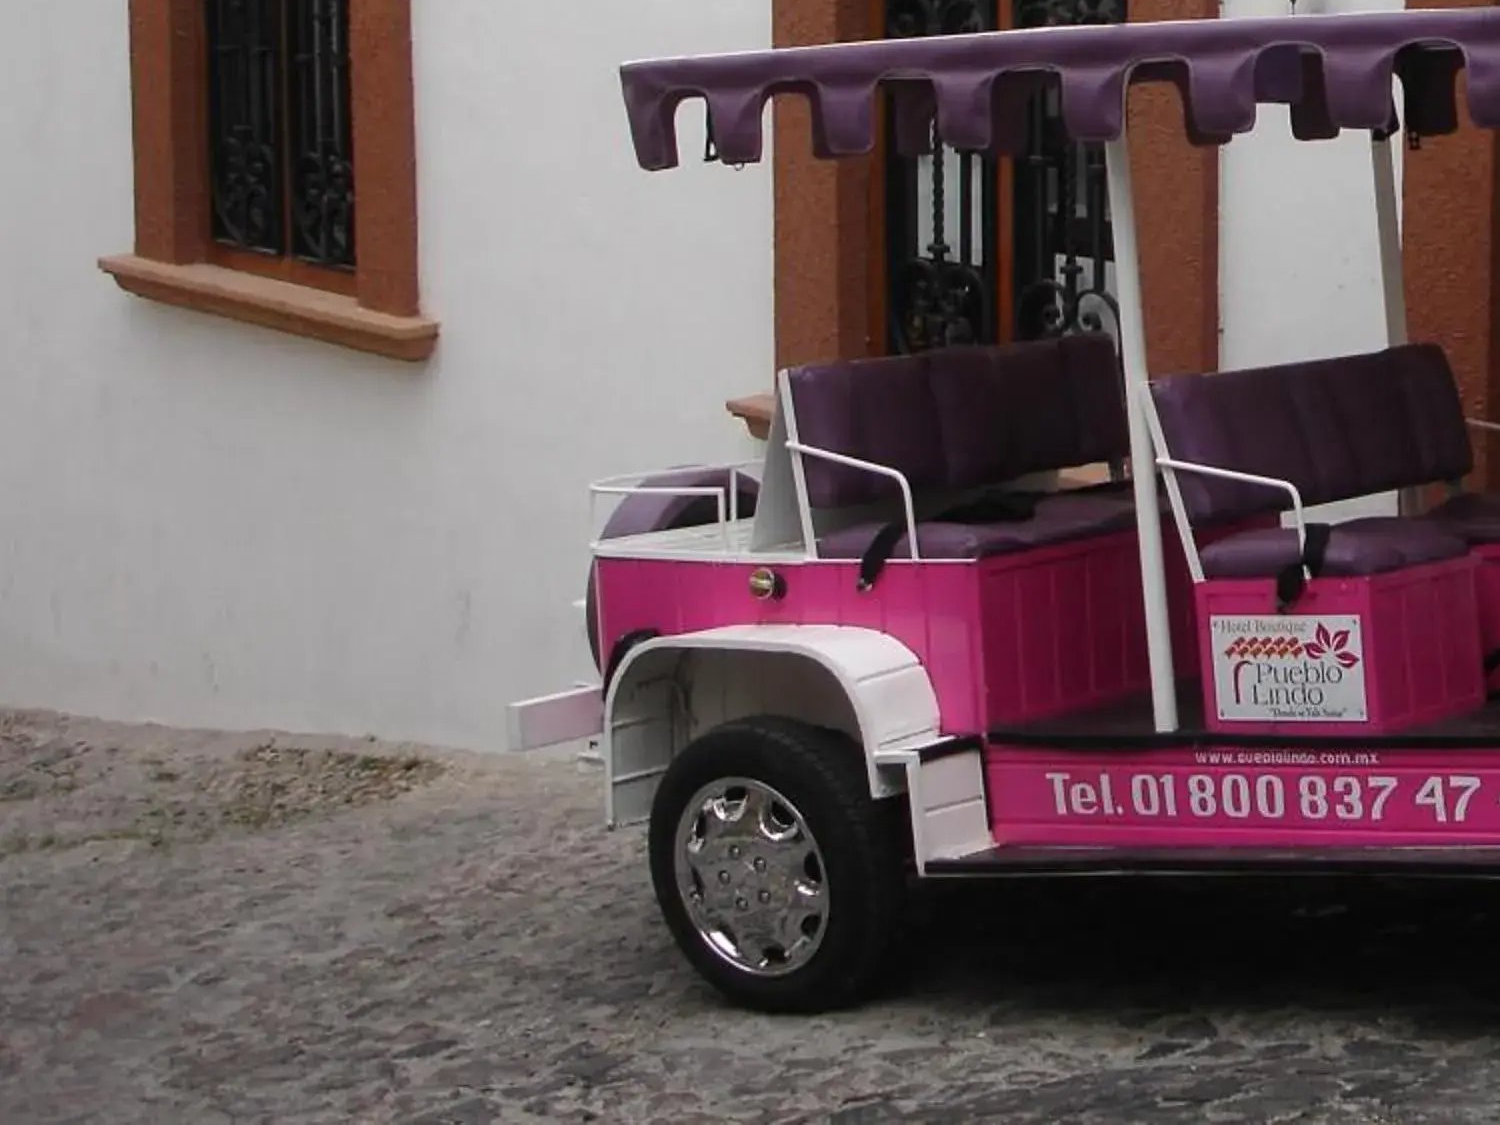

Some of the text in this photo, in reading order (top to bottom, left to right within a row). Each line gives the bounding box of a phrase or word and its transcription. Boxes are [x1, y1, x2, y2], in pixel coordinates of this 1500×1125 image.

[1219, 619, 1250, 635] Hotel
[1256, 660, 1343, 685] Pueblo
[1251, 683, 1324, 706] Lindo
[1046, 773, 1123, 817] Tel.
[1132, 773, 1176, 817] 01
[1190, 774, 1285, 818] 800
[1299, 776, 1398, 821] 837
[1415, 776, 1482, 823] 47
